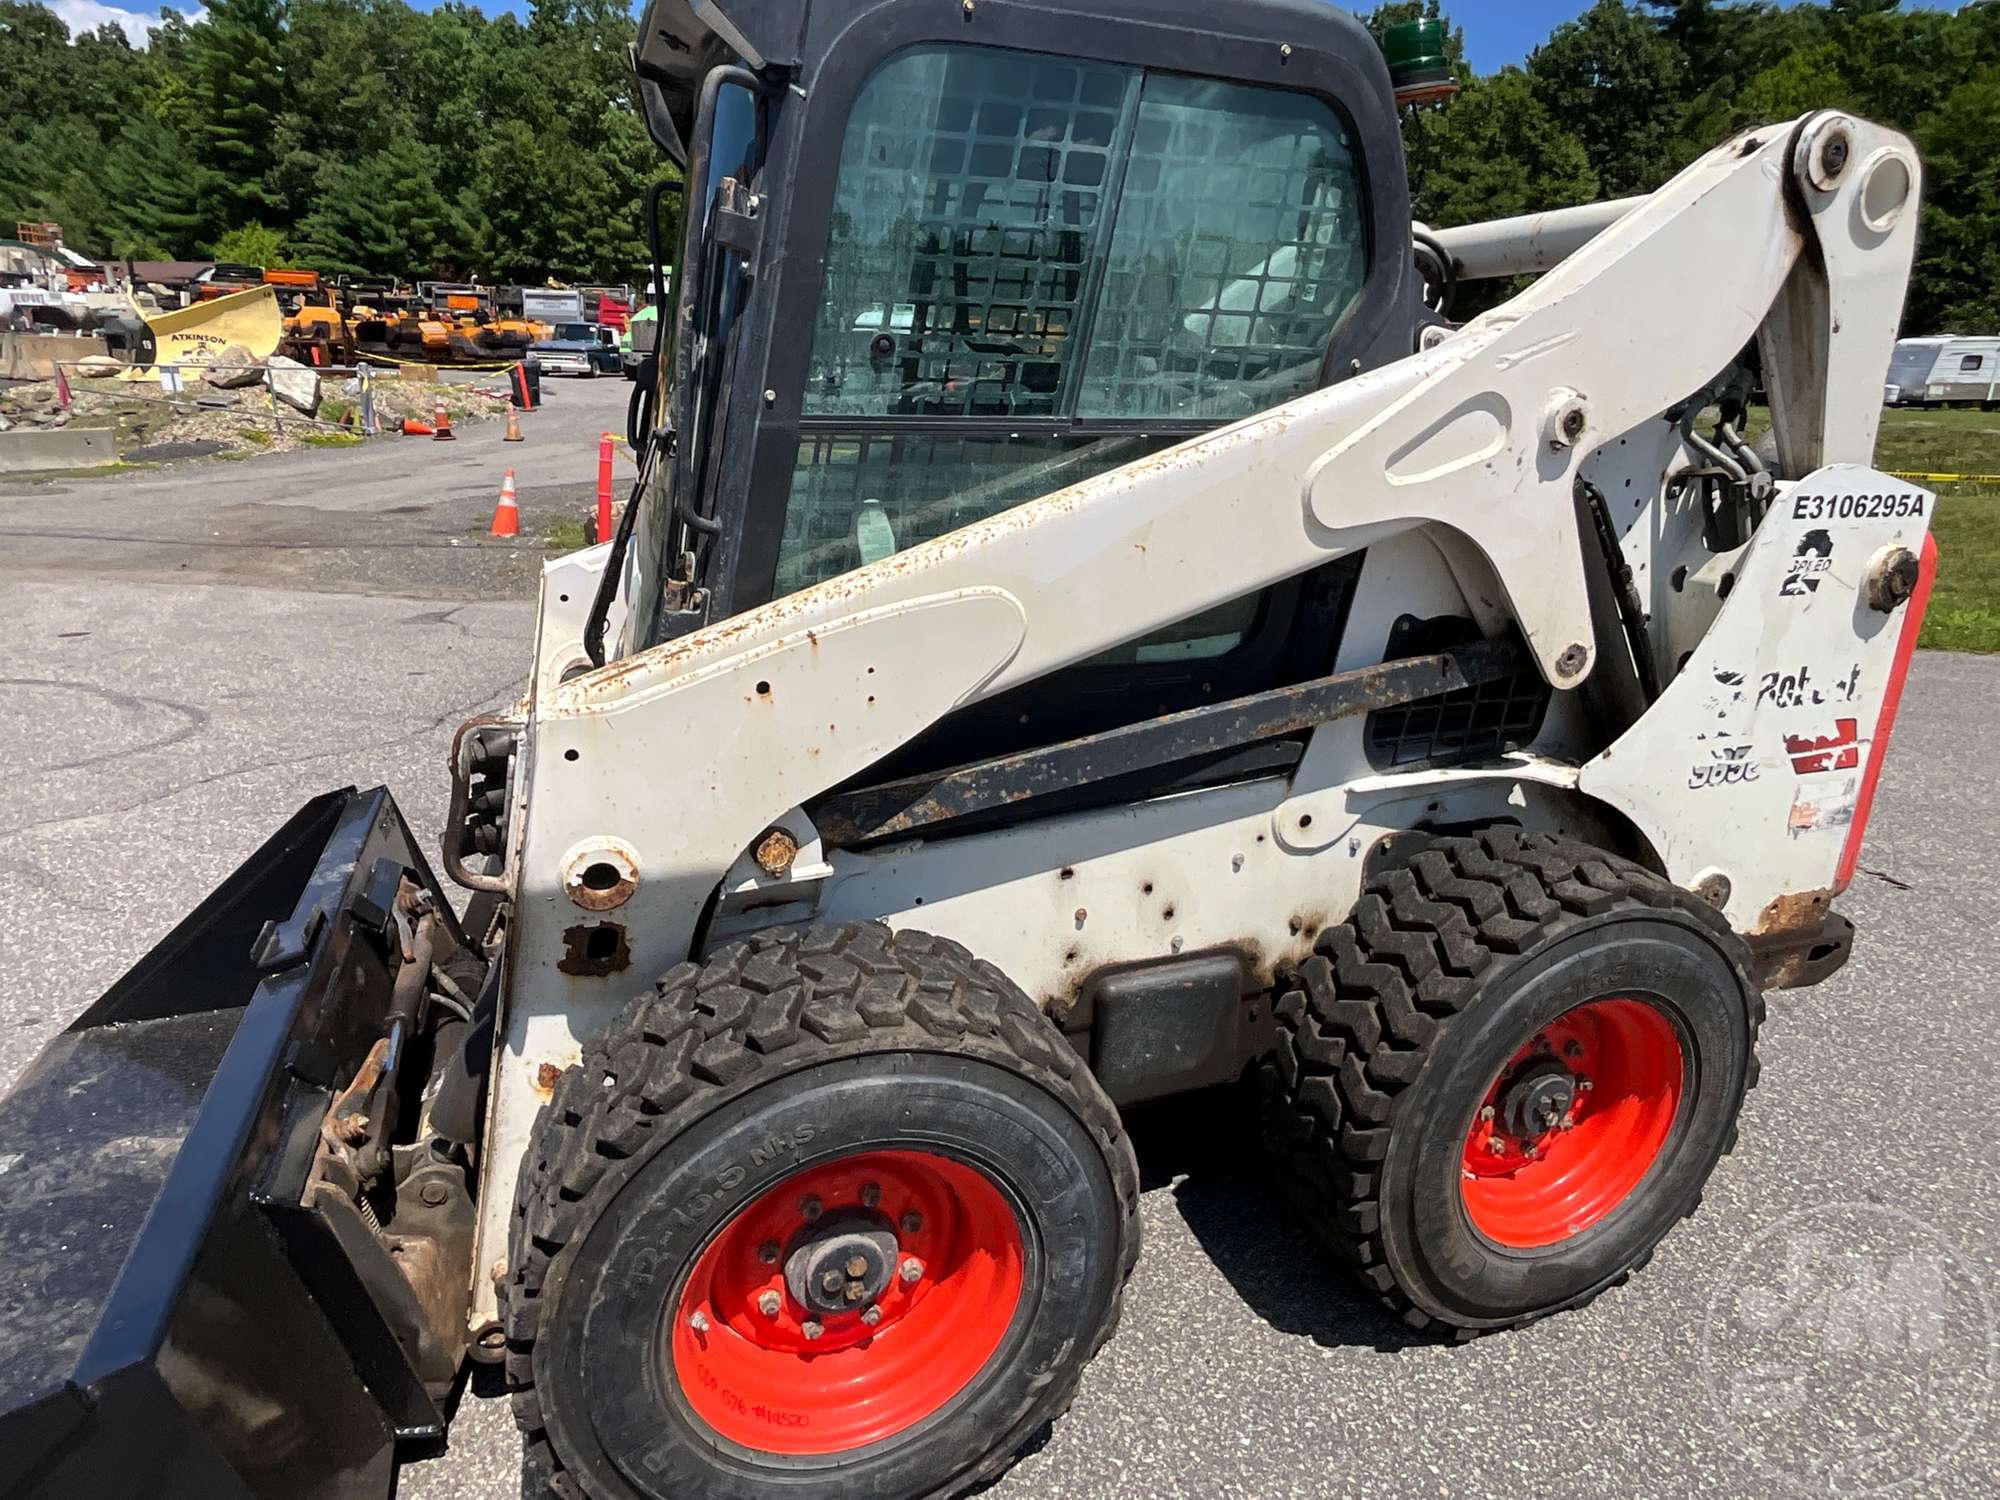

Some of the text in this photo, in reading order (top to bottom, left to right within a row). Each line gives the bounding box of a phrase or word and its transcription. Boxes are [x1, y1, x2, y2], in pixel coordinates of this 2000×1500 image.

[171, 333, 227, 345] ATKINSON
[1792, 494, 1924, 520] E3106295A
[750, 1123, 816, 1167] NHS
